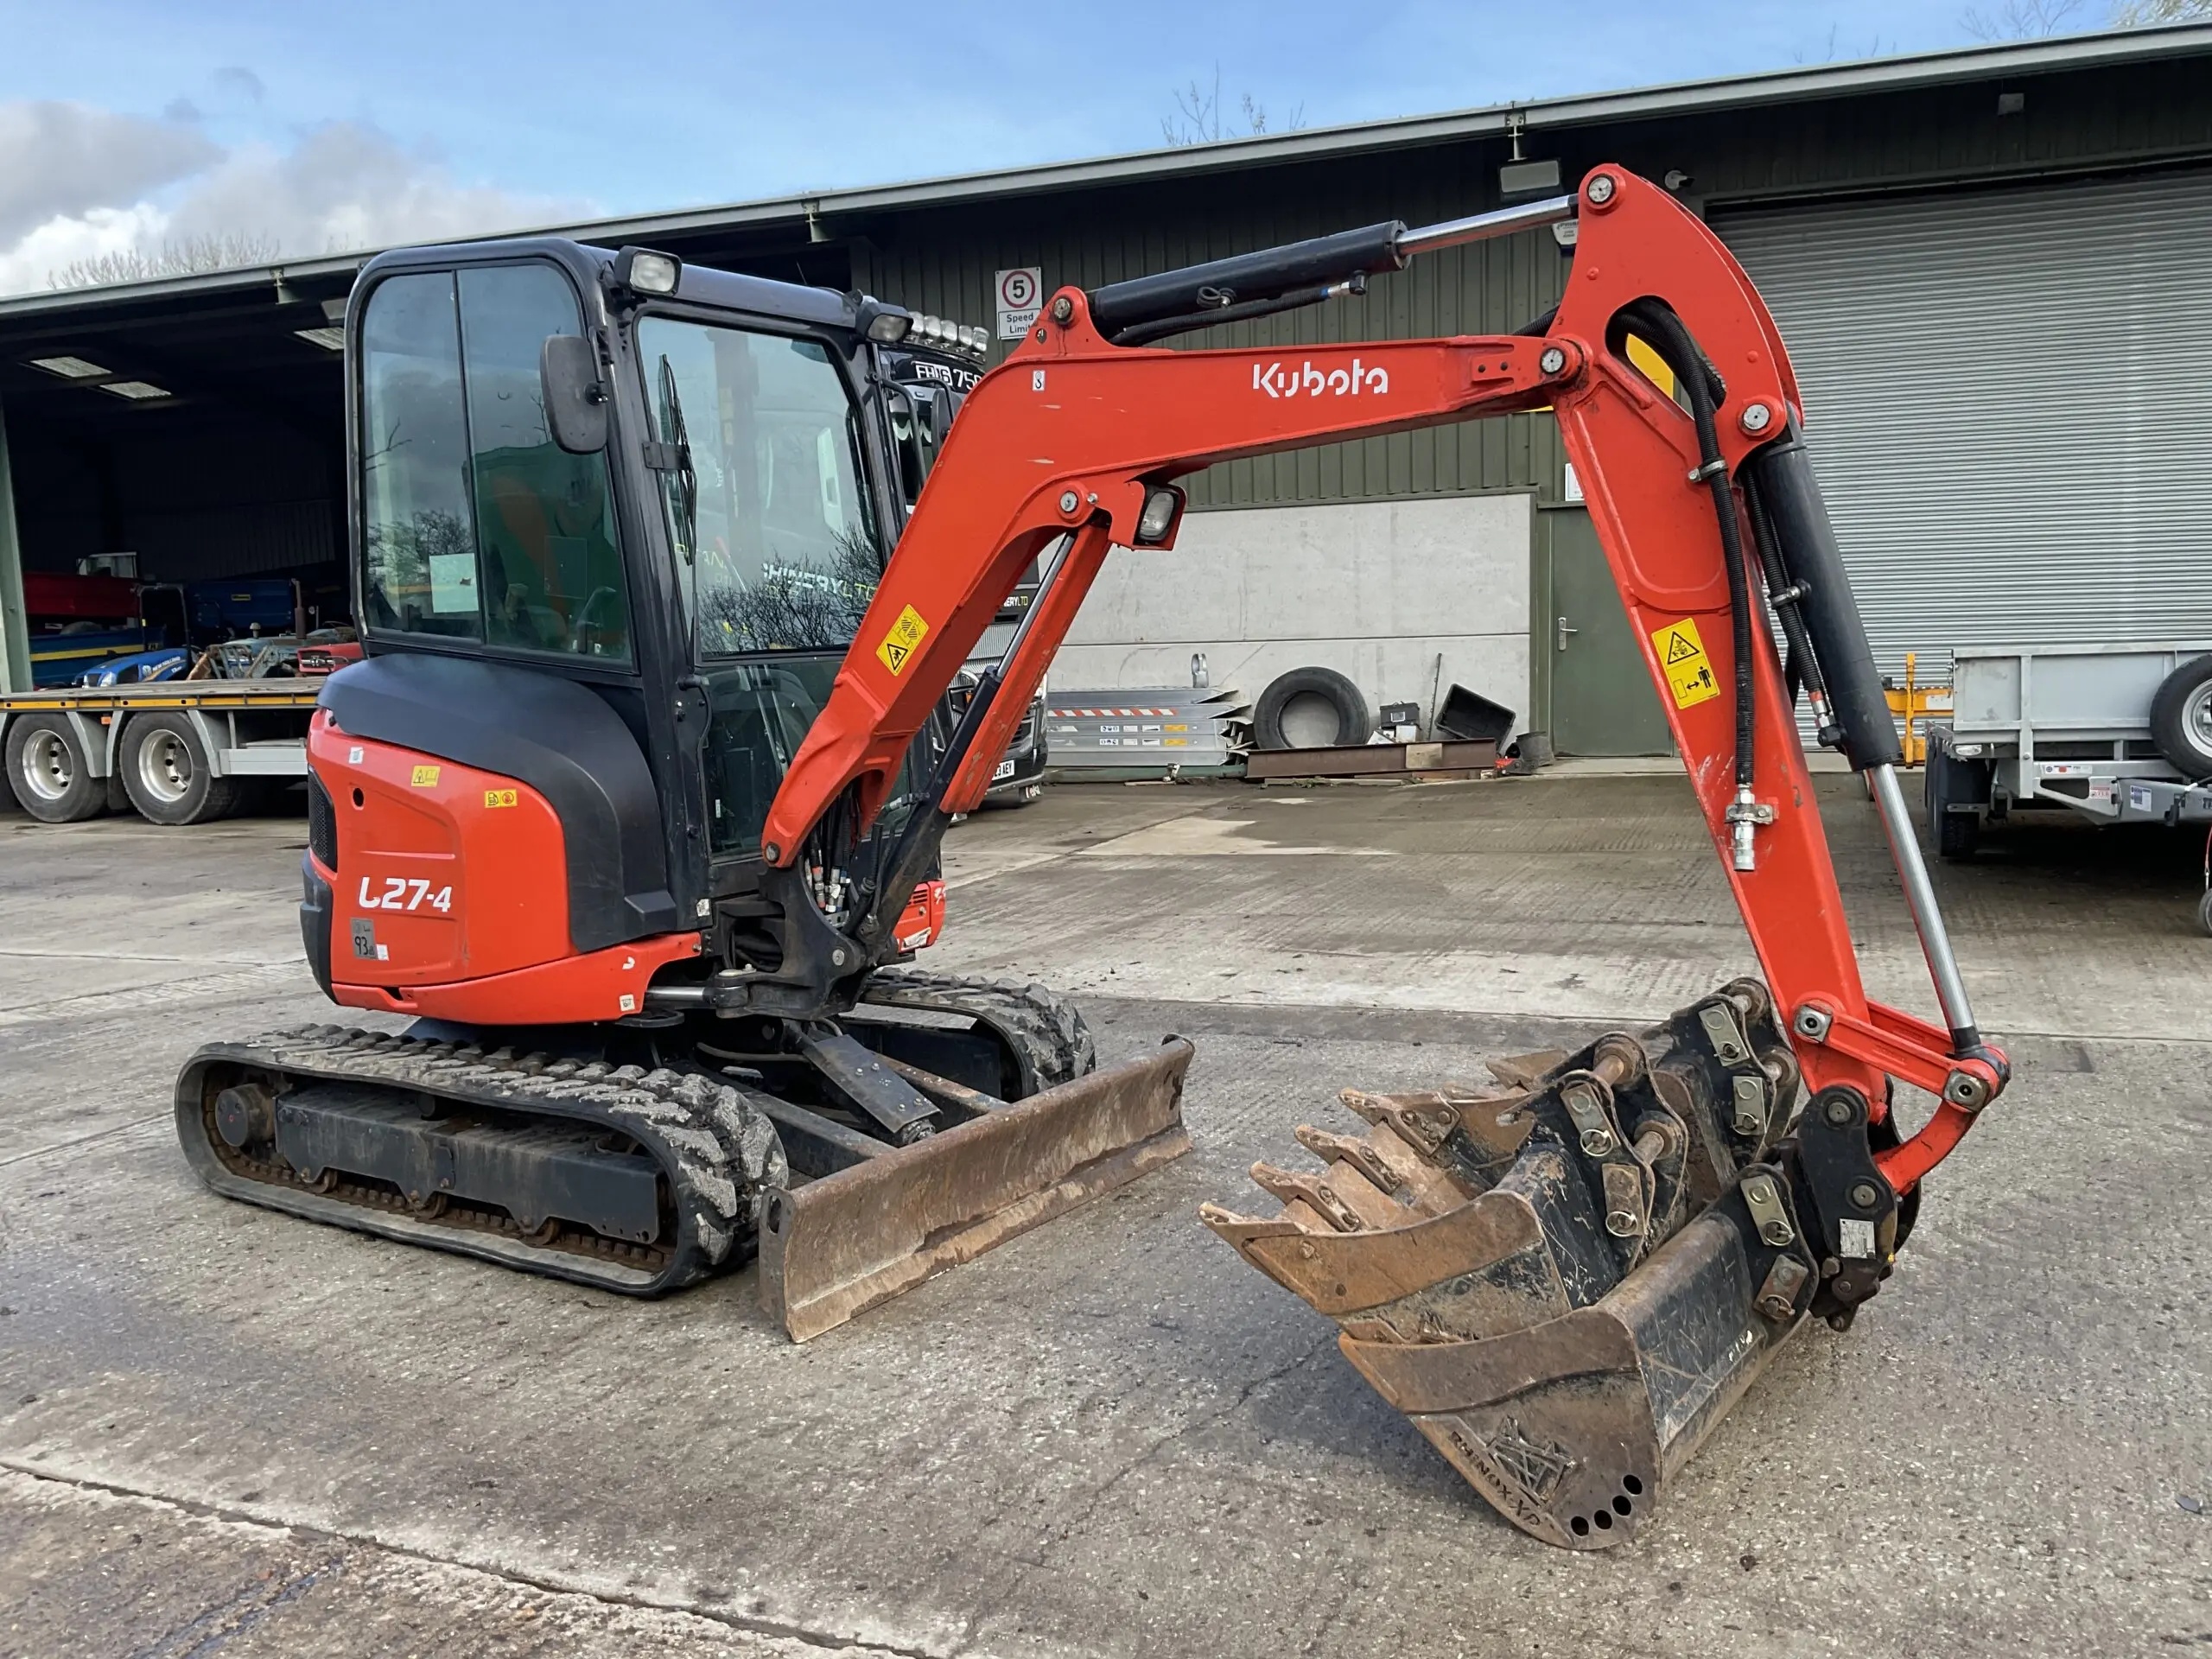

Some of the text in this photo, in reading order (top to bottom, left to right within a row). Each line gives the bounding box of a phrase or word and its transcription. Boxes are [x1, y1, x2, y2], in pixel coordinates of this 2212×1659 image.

[1013, 280, 1025, 298] 5
[1007, 312, 1033, 323] Speed
[1009, 325, 1031, 334] Limi
[1253, 359, 1389, 397] Kubota
[1002, 762, 1013, 774] AEY
[359, 877, 452, 912] L27-4
[354, 936, 368, 956] 93
